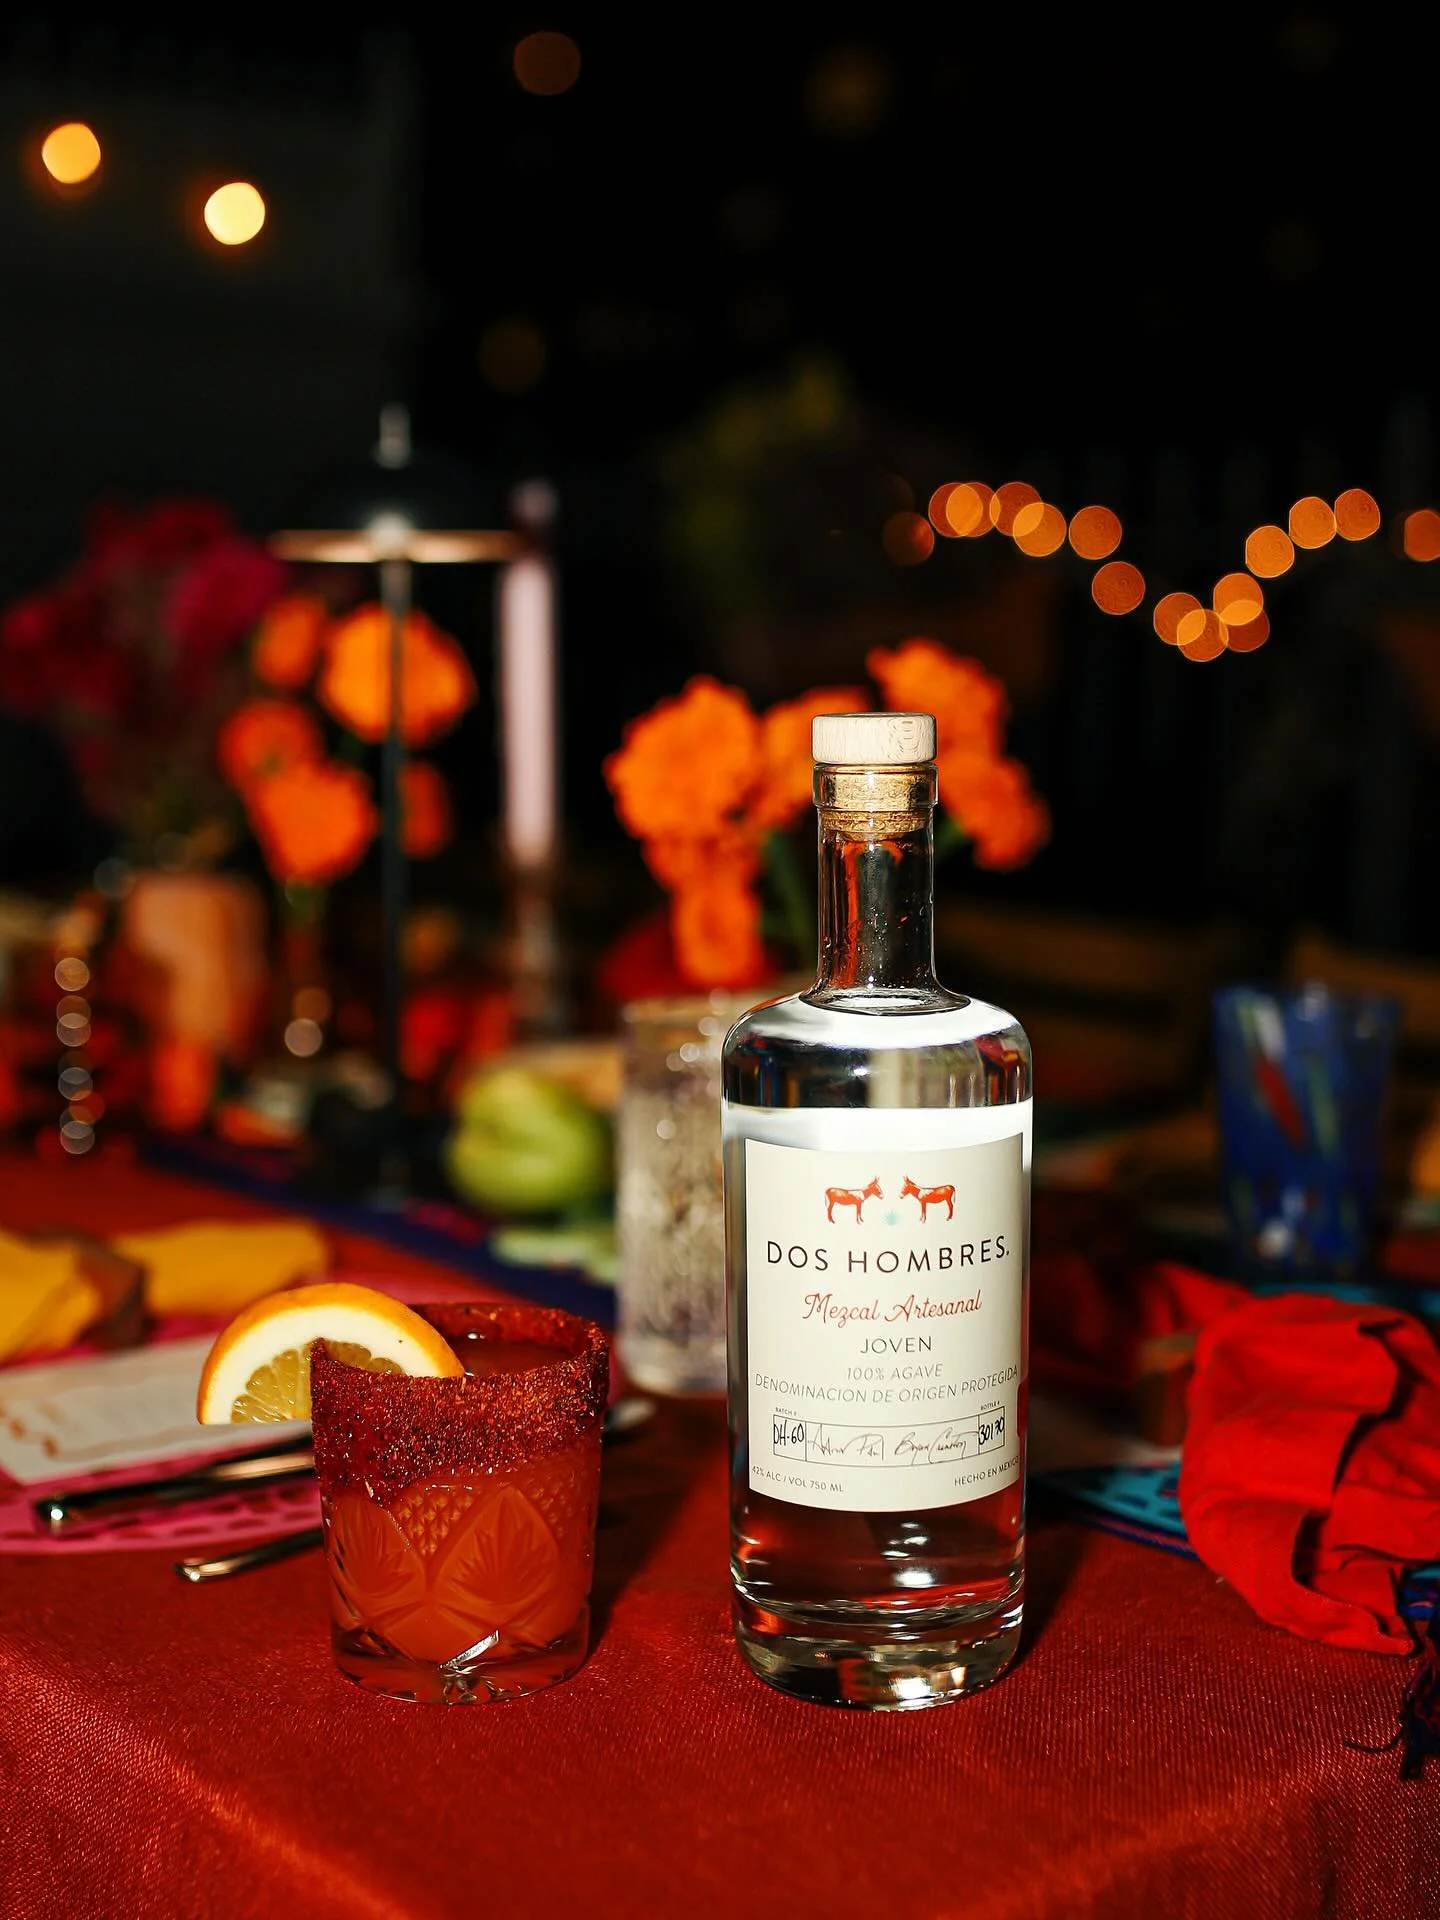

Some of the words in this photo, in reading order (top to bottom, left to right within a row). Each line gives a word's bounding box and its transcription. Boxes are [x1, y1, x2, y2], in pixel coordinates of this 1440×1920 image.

[767, 1240, 829, 1271] DOS
[802, 1293, 880, 1328] Mezcal
[884, 1289, 983, 1322] Artesanal
[860, 1336, 932, 1354] JOVEN
[755, 1373, 867, 1402] DENOMINACION
[872, 1390, 893, 1403] DE
[898, 1384, 957, 1402] ORIGEN
[961, 1365, 1018, 1395] PROTEGIDA
[847, 1365, 885, 1381] 100%
[891, 1363, 943, 1380] AGAVE
[775, 1407, 793, 1416] BATCH
[773, 1419, 805, 1446] DH-60
[752, 1465, 764, 1476] 42%
[766, 1471, 781, 1482] ALC
[788, 1476, 807, 1488] VOL
[810, 1480, 827, 1490] 750
[830, 1483, 844, 1492] ML
[954, 1471, 985, 1486] HECHO
[987, 1466, 997, 1478] EN
